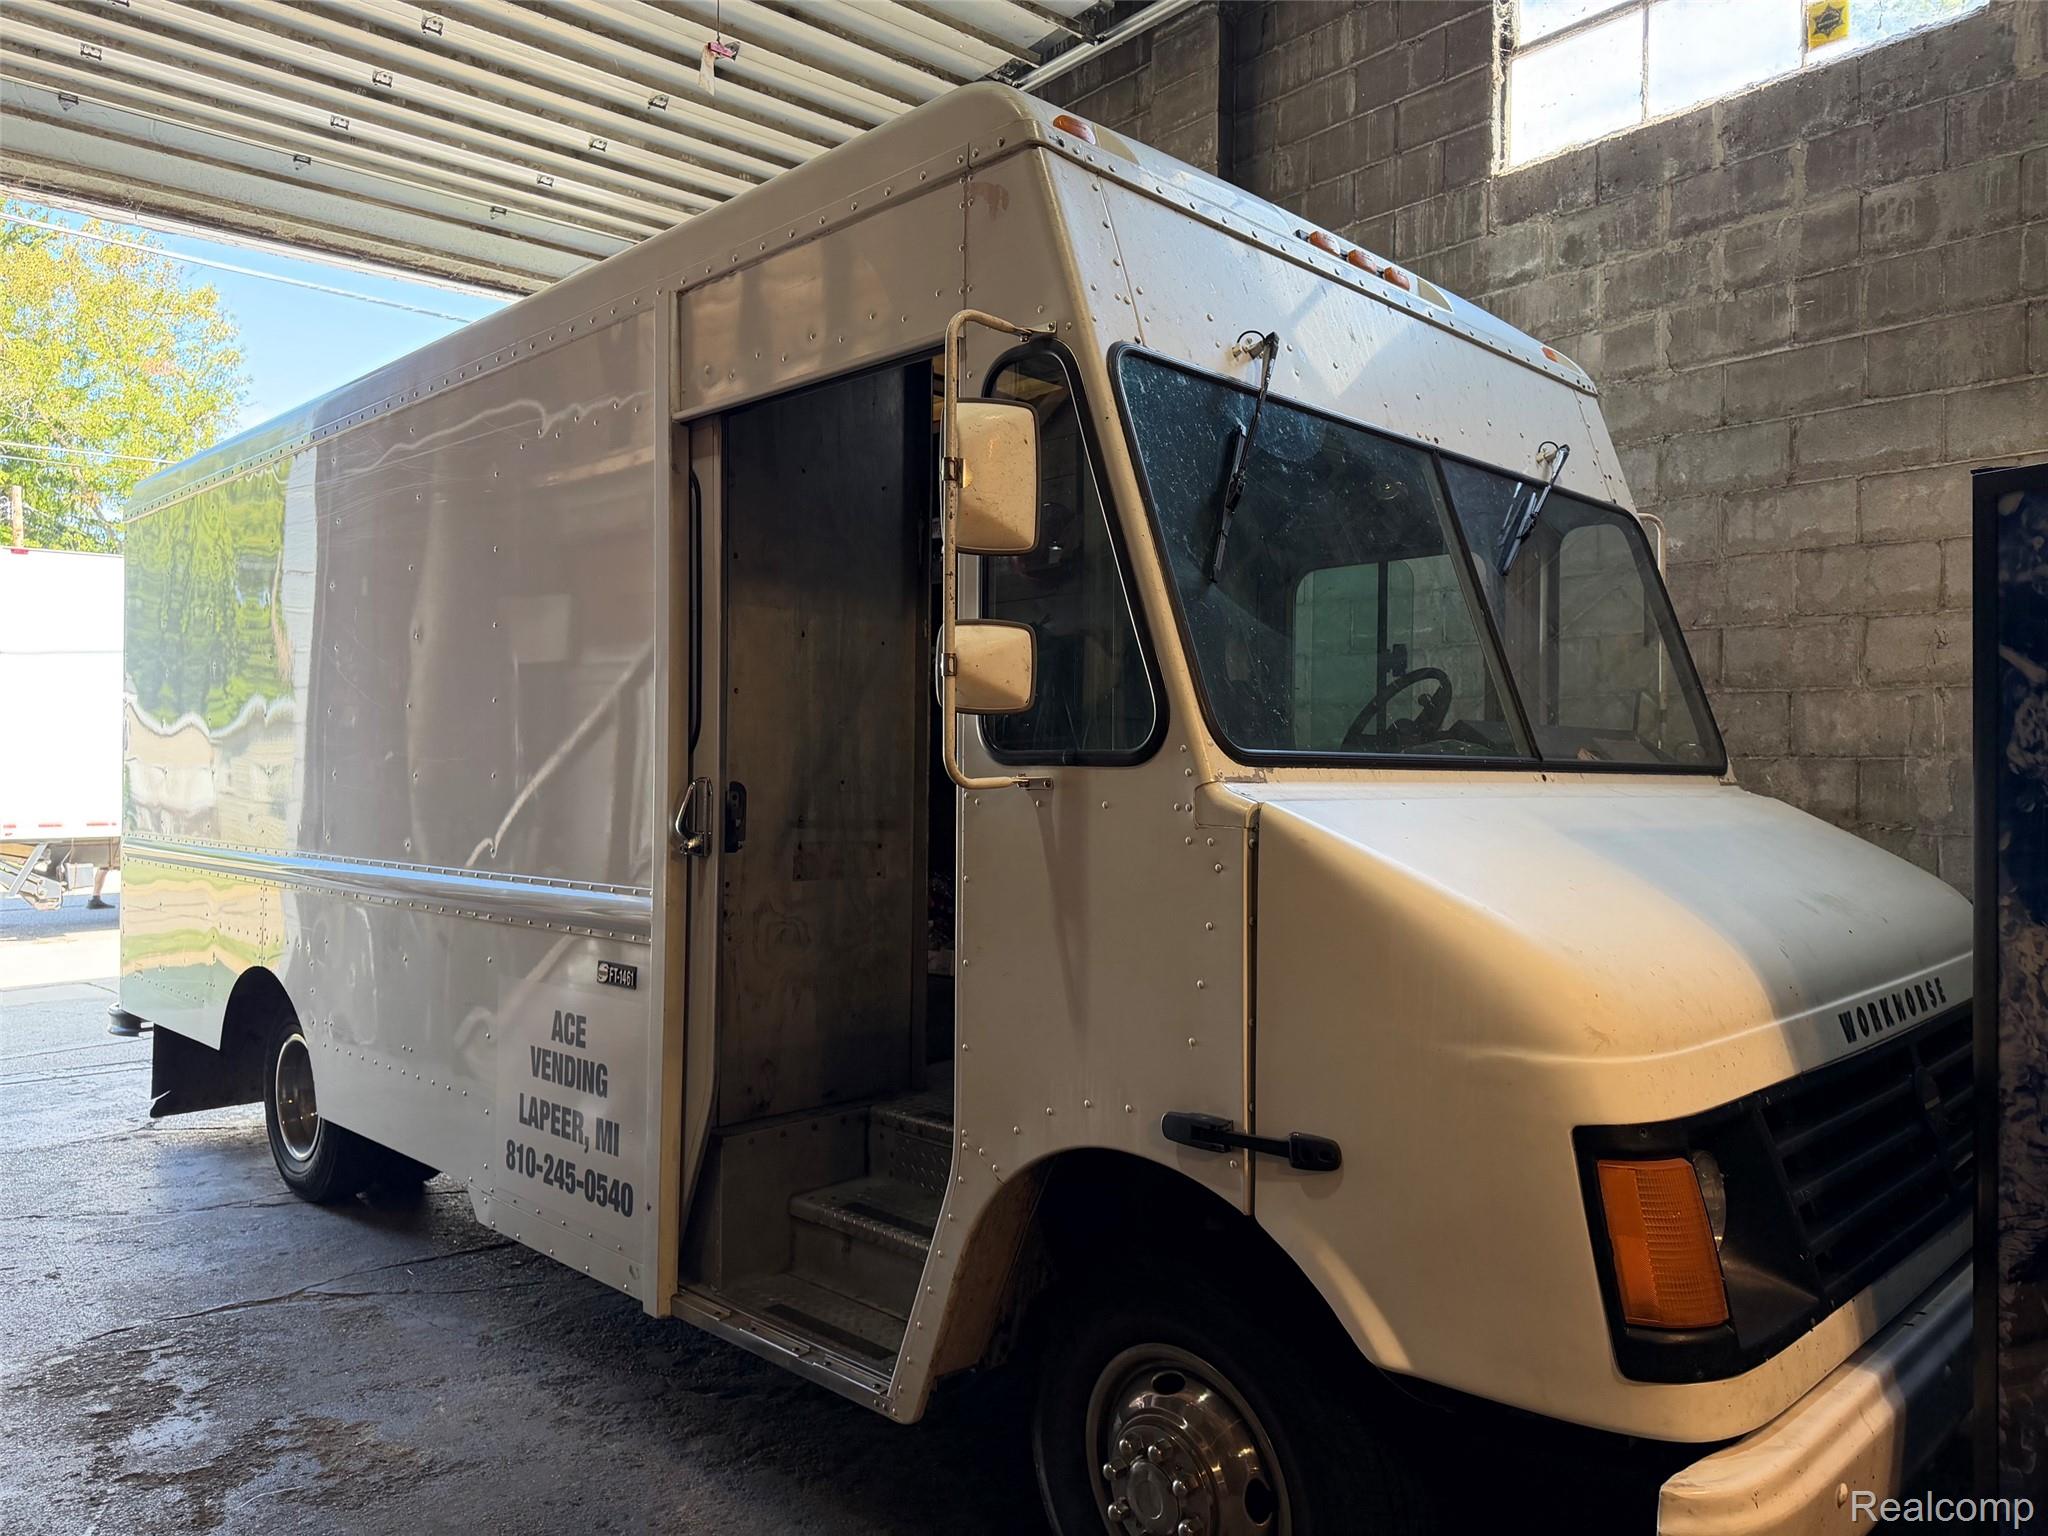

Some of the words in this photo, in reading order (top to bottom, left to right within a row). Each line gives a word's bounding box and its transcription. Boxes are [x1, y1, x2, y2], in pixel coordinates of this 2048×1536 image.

[551, 1010, 586, 1048] ACE
[1838, 977, 1947, 1044] WORKHORSE
[530, 1045, 608, 1098] VENDING
[519, 1093, 590, 1153] LAPEER,
[595, 1117, 619, 1157] MI
[506, 1139, 634, 1218] 810-245-0540
